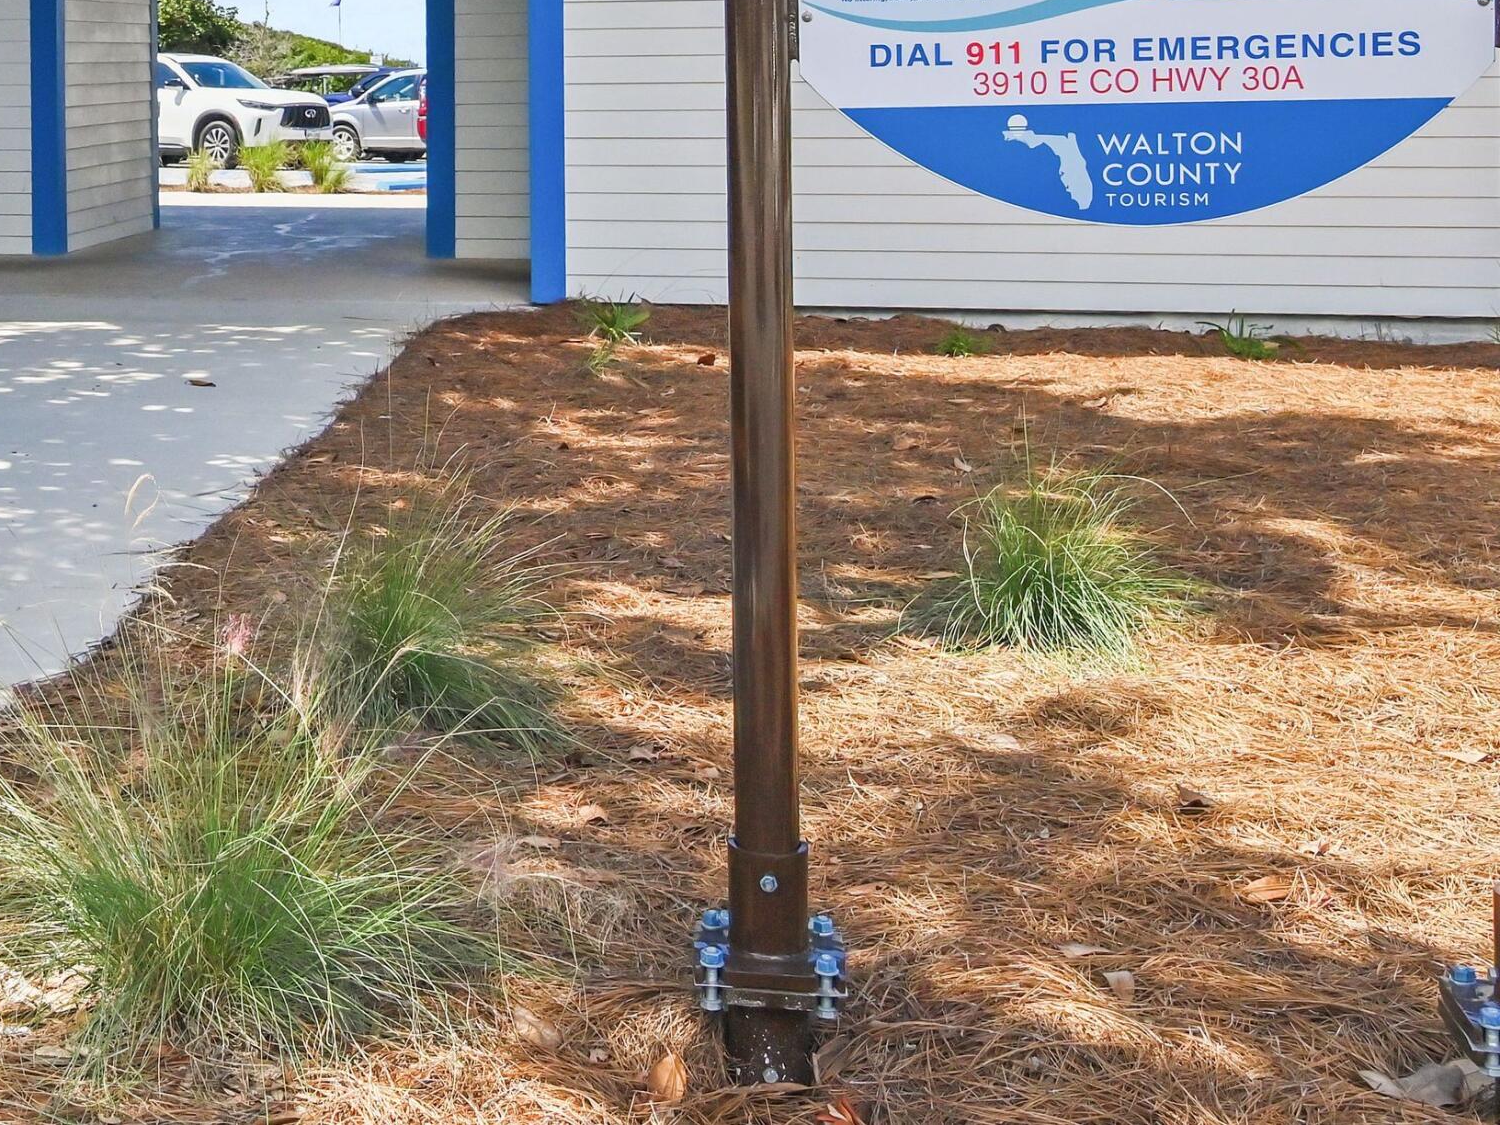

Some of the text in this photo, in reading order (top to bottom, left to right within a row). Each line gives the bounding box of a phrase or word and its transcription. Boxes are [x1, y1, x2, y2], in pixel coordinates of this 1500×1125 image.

[870, 30, 1420, 67] DIAL 911 FOR EMERGENCIES
[973, 65, 1304, 96] 3910 E CO HWY 30A
[1097, 131, 1242, 155] WALTON
[1102, 162, 1241, 186] COUNTY
[1105, 192, 1208, 207] TOURISM
